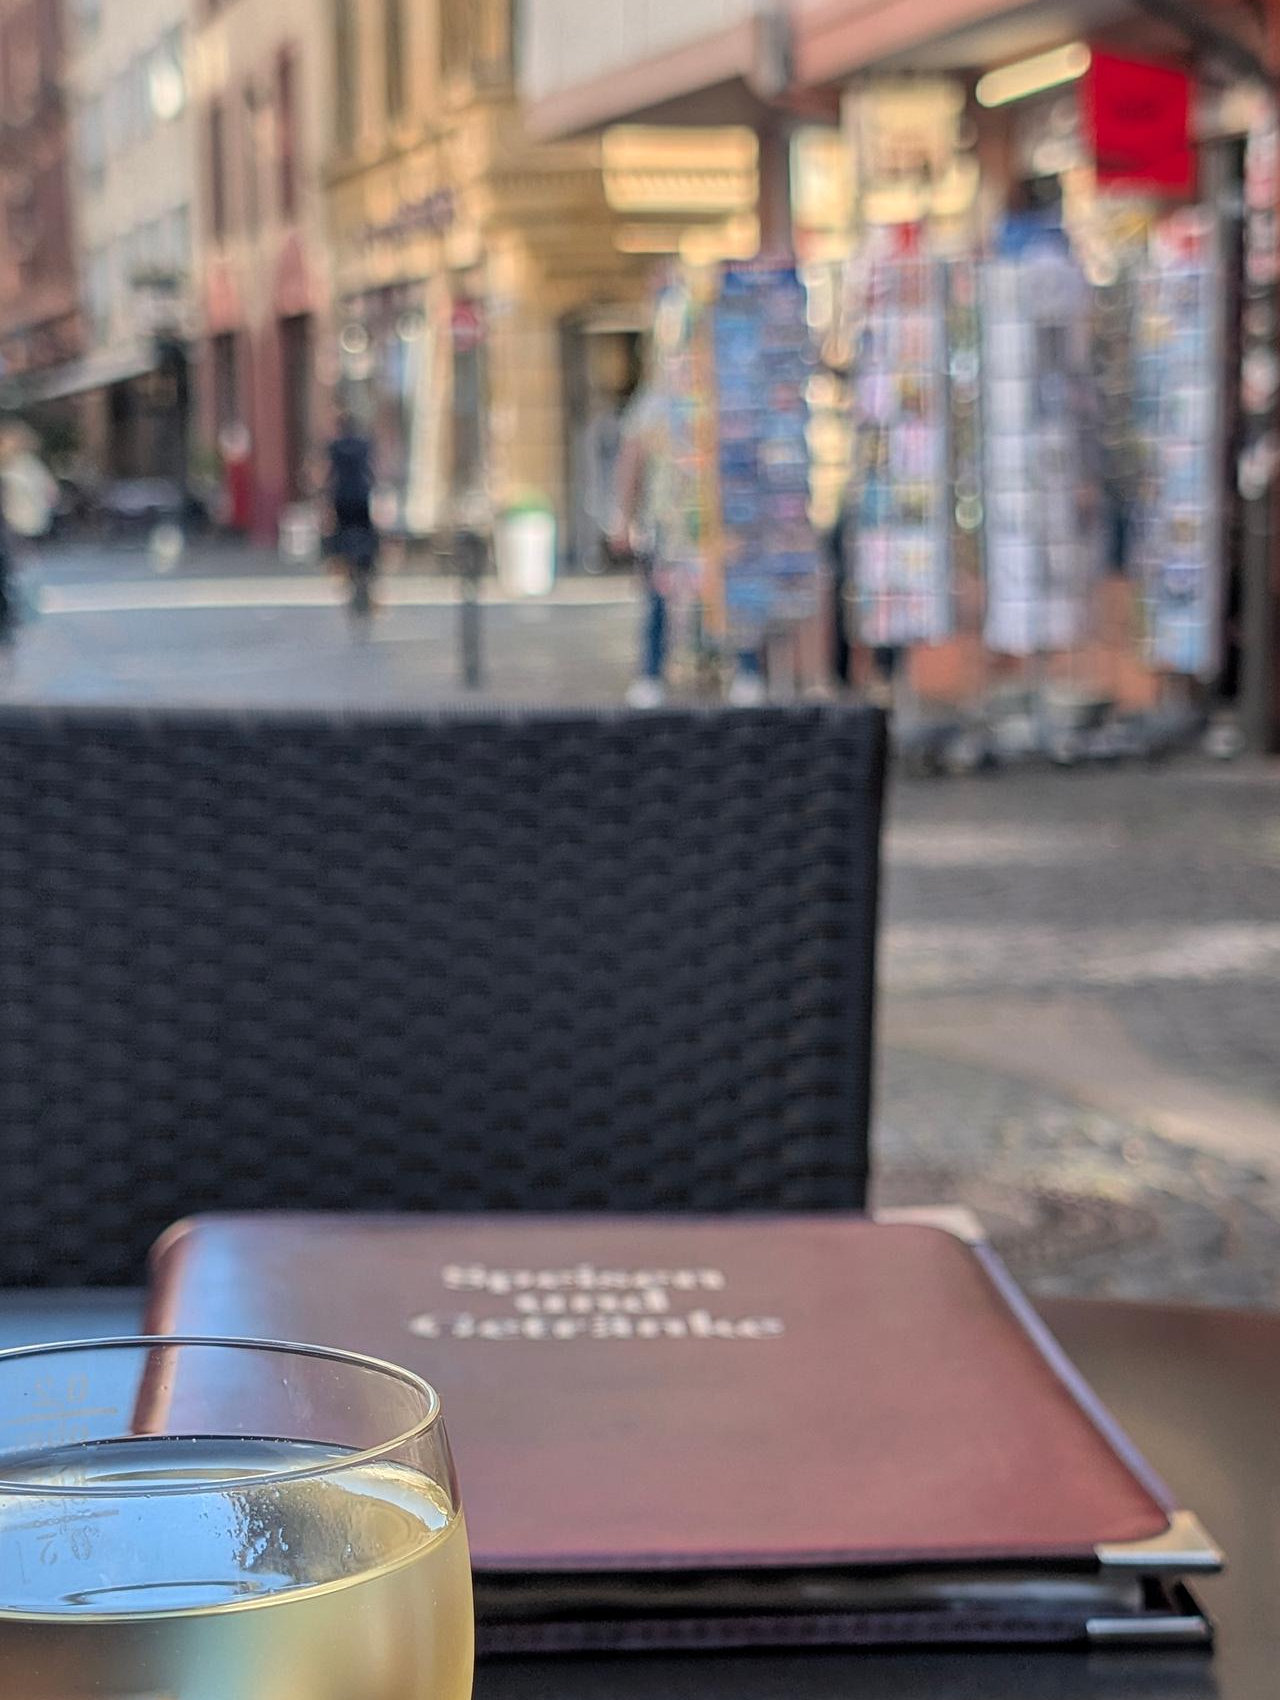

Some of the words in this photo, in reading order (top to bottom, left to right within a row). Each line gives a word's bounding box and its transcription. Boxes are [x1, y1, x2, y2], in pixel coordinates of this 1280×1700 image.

[440, 1262, 726, 1293] Speisen
[514, 1288, 670, 1314] und
[408, 1308, 785, 1341] Getränke
